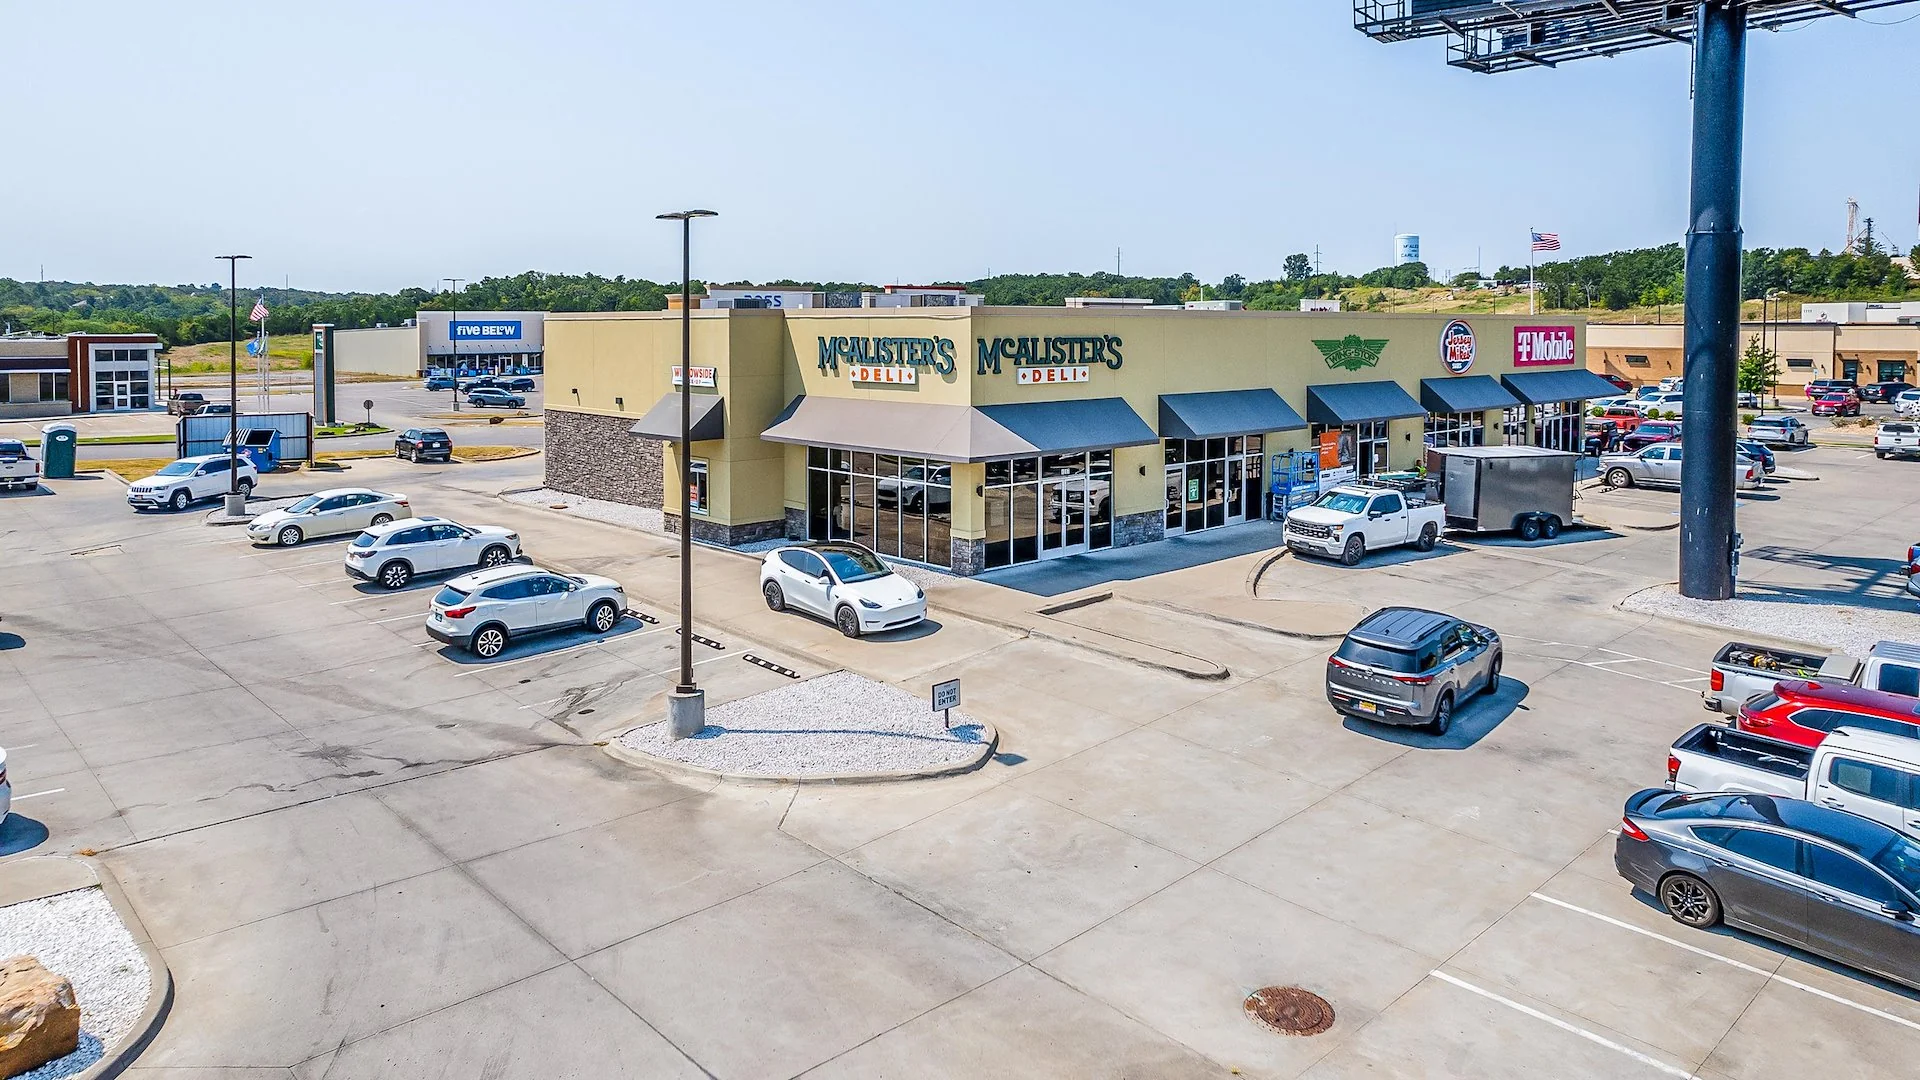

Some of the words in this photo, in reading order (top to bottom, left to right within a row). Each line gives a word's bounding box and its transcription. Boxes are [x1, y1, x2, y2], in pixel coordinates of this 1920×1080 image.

[673, 367, 712, 379] WIOWSIDE
[860, 367, 902, 382] DELI
[1032, 368, 1077, 383] DELI
[946, 688, 956, 696] NOT
[938, 695, 956, 705] ENTER
